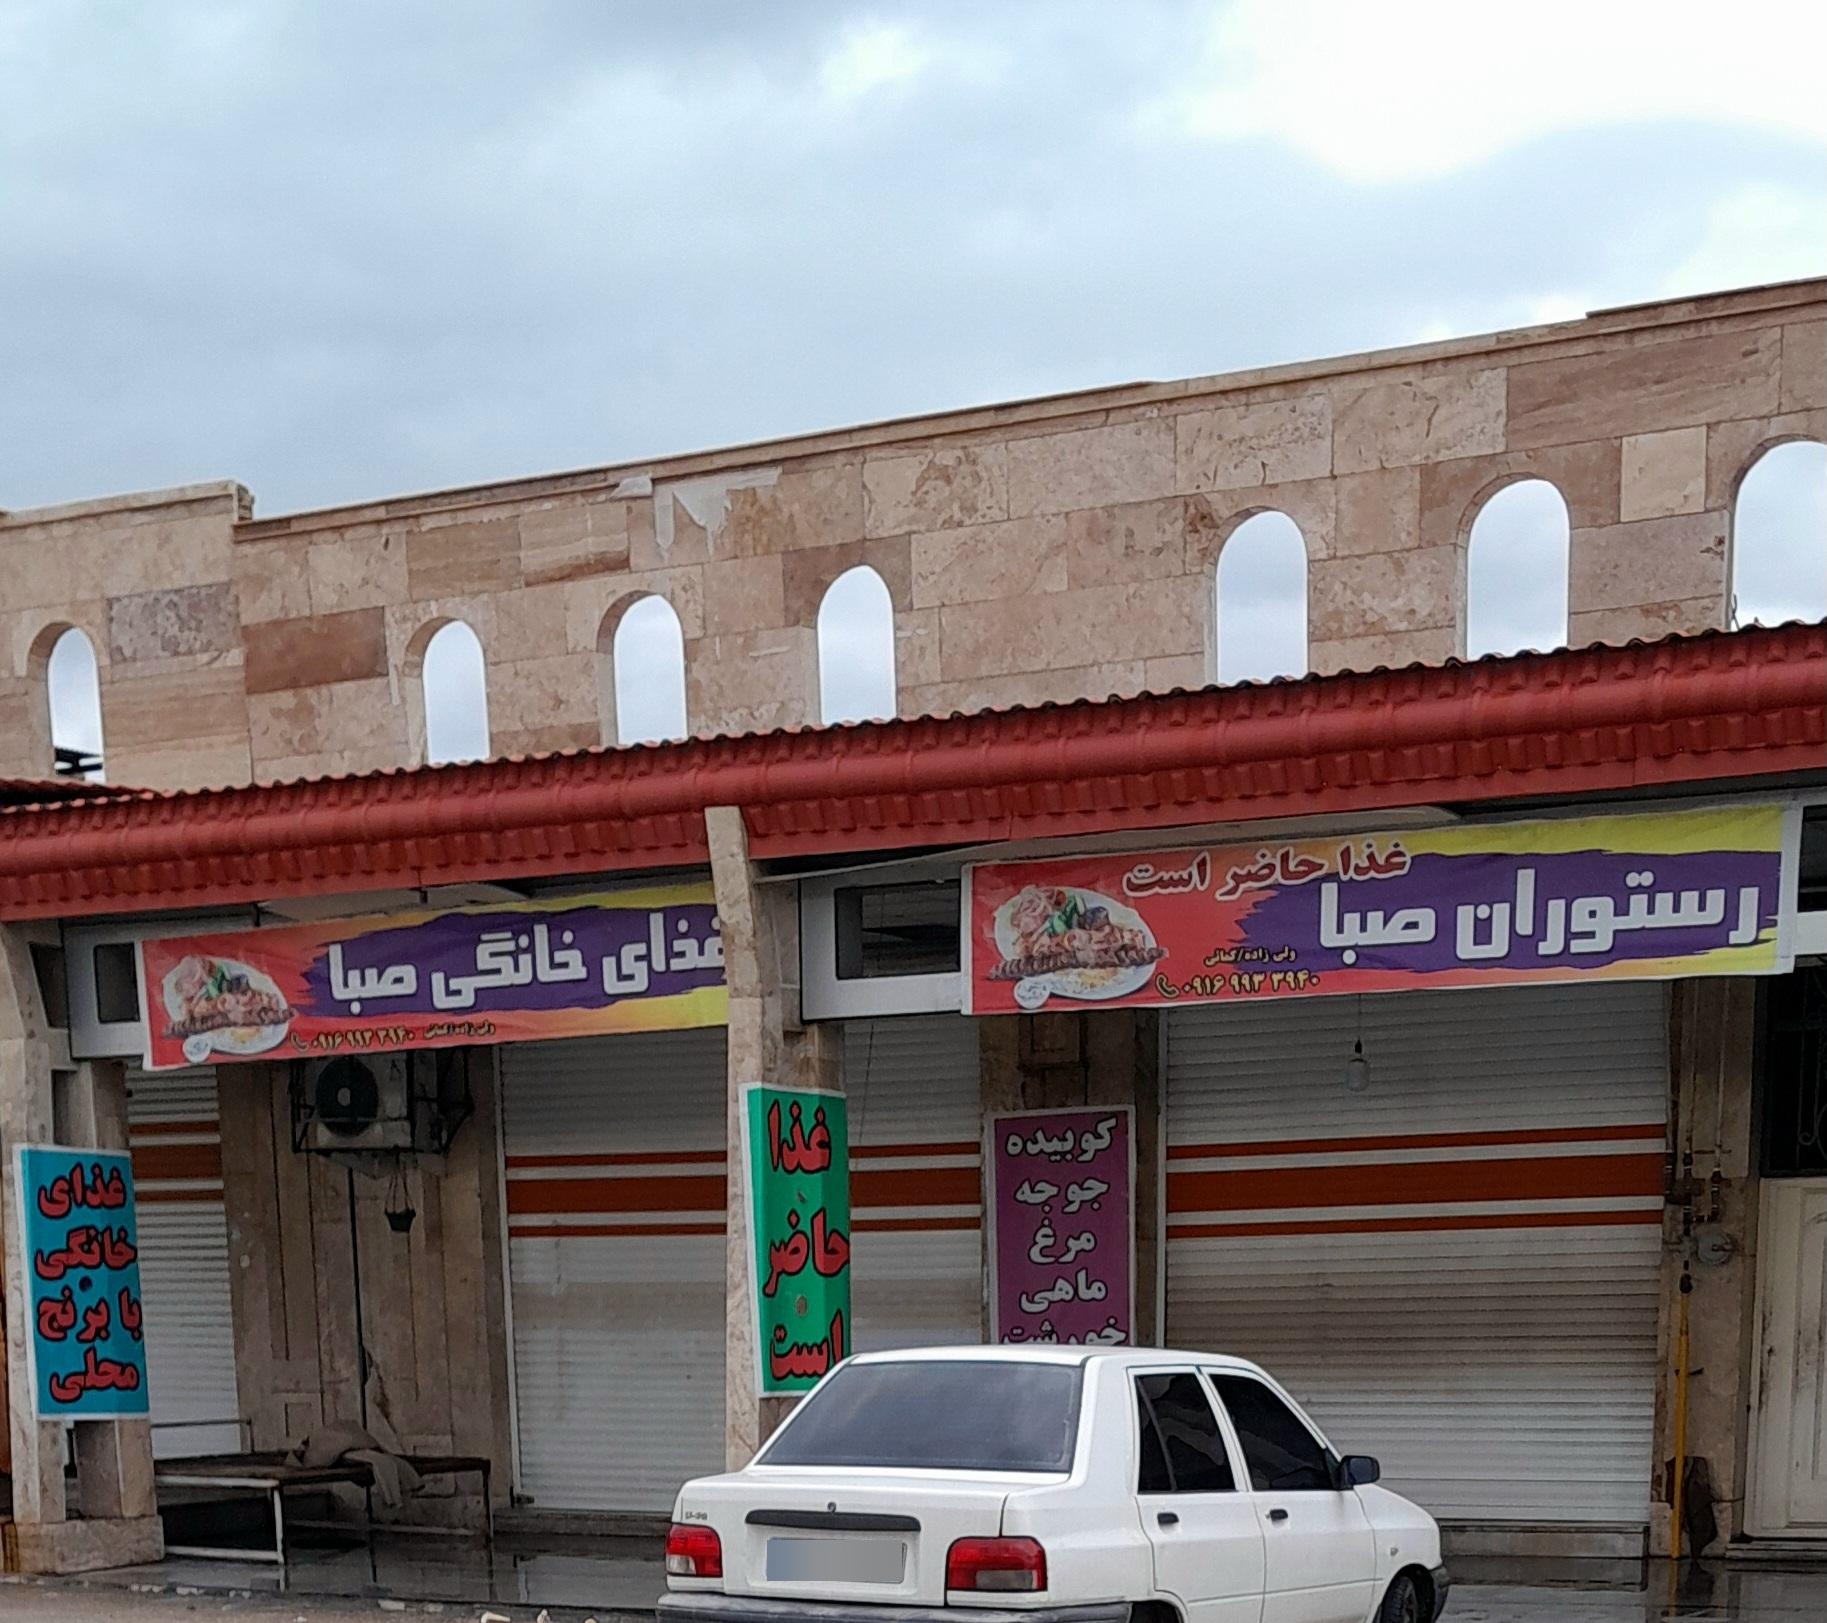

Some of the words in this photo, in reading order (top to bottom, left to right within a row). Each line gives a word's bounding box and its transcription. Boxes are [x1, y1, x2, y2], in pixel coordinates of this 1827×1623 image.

[1122, 851, 1211, 896] است
[1216, 843, 1329, 899] حاضر
[1338, 841, 1411, 881] غذا
[1319, 881, 1437, 965] صبا
[1456, 867, 1760, 960] رستوران
[327, 943, 418, 1015] صبا
[430, 923, 588, 1010] خانگی
[602, 912, 726, 995] غذای
[768, 1099, 831, 1174] غذا
[1005, 1117, 1119, 1162] کوبیده
[38, 1161, 126, 1217] غذای
[1014, 1177, 1110, 1214] جوجه
[35, 1226, 138, 1280] خانگی
[763, 1206, 850, 1298] حاضر
[1028, 1216, 1097, 1265] مرغ
[37, 1285, 111, 1343] برنج
[118, 1287, 142, 1340] با
[1019, 1267, 1109, 1314] ماهی
[769, 1308, 844, 1380] است
[50, 1344, 140, 1403] محلی
